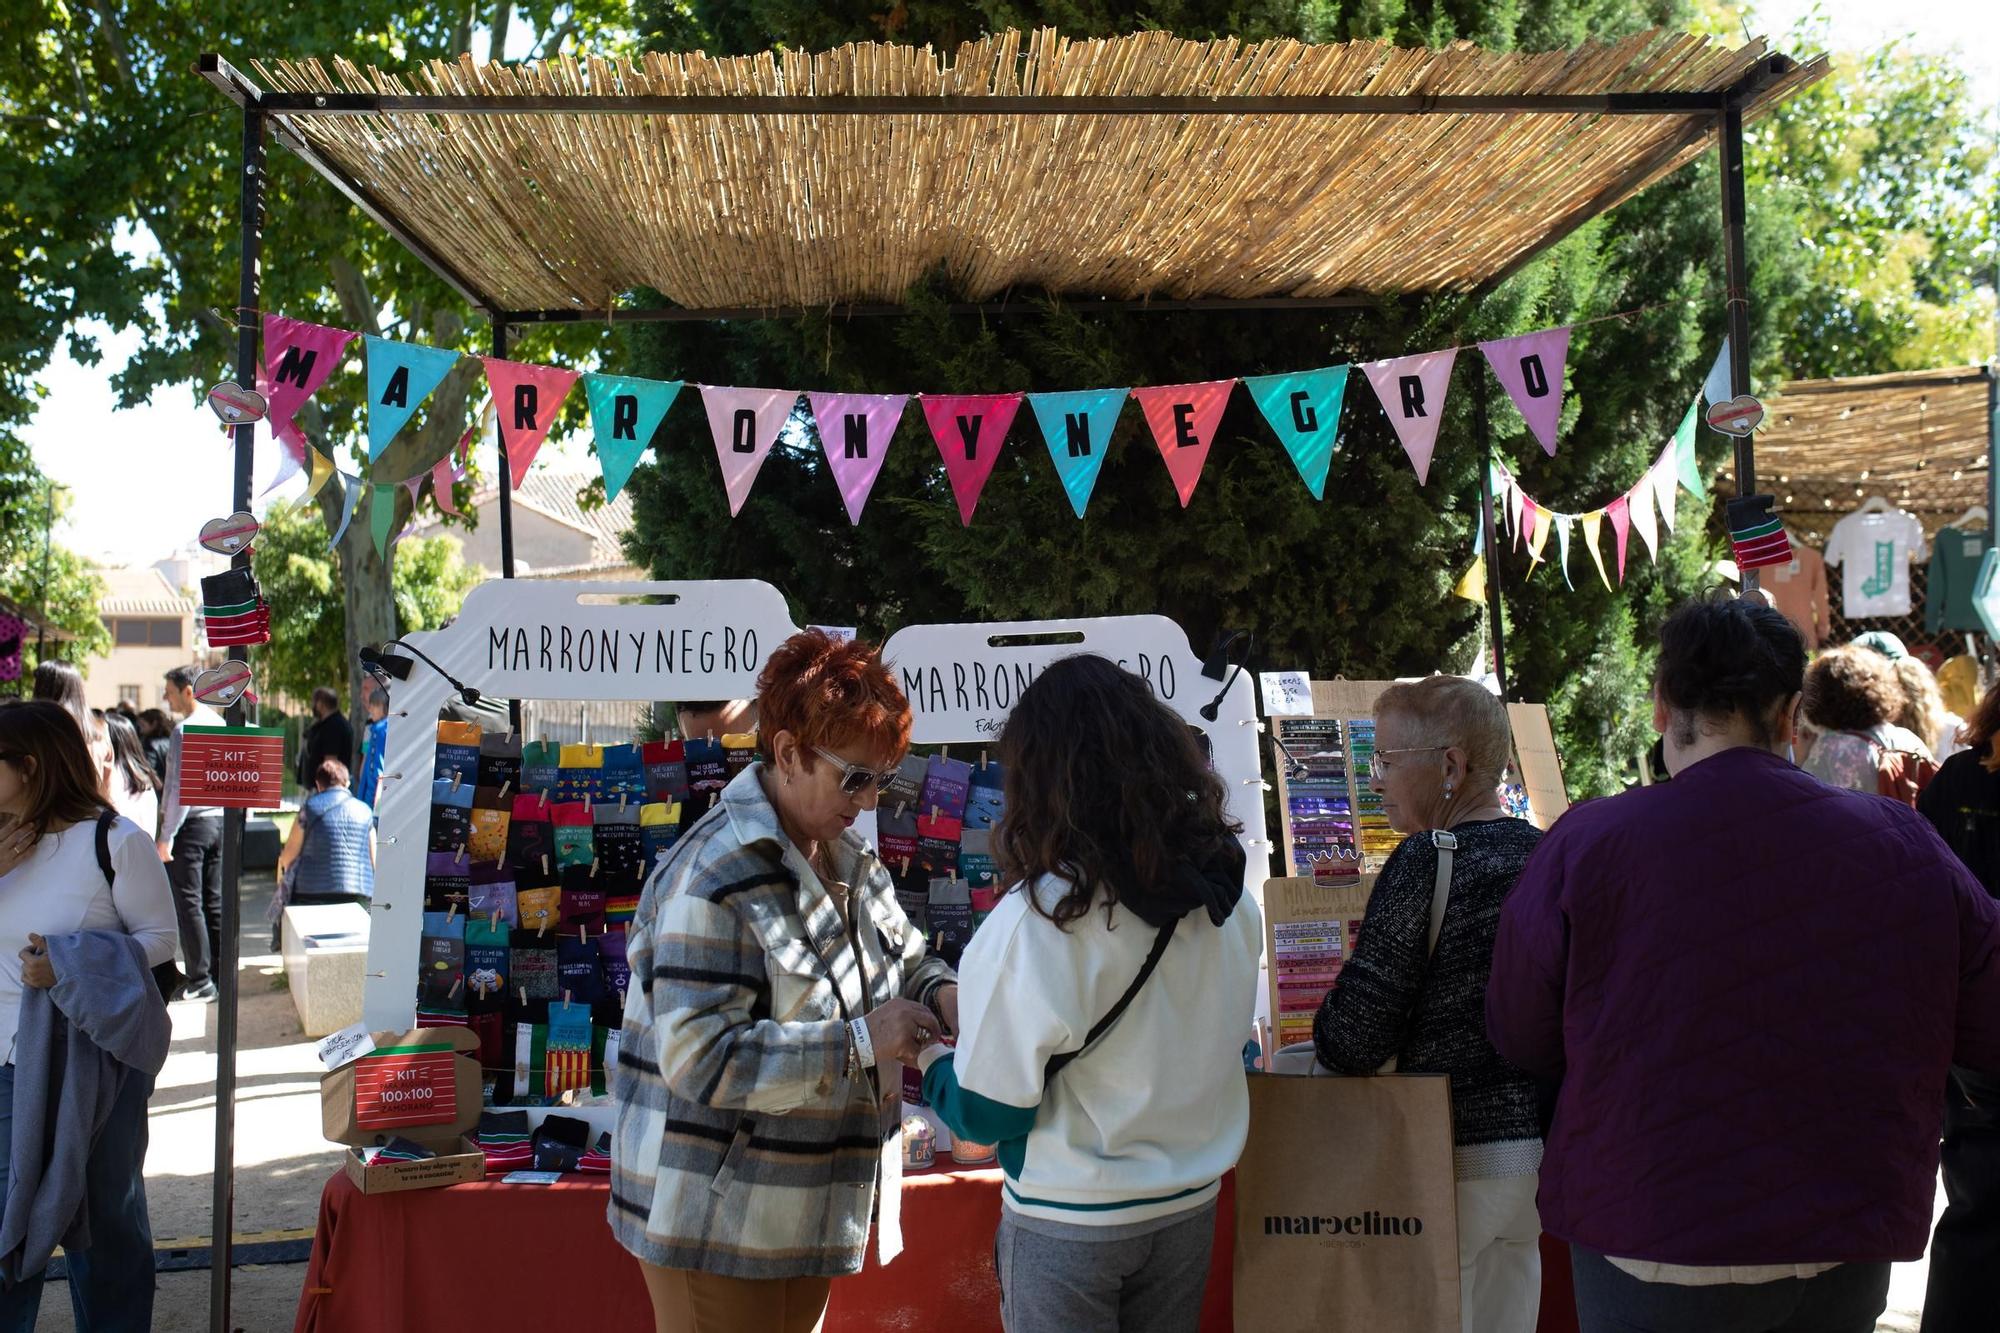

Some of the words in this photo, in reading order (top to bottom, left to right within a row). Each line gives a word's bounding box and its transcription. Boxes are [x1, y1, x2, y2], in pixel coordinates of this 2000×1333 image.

[224, 752, 246, 761] KIT
[204, 770, 260, 782] 100x100
[204, 785, 259, 793] ZAMORANO
[397, 1069, 417, 1080] KIT
[380, 1087, 433, 1103] 100x100
[380, 1102, 433, 1113] ZAMORANO
[1264, 1211, 1423, 1236] marcelino
